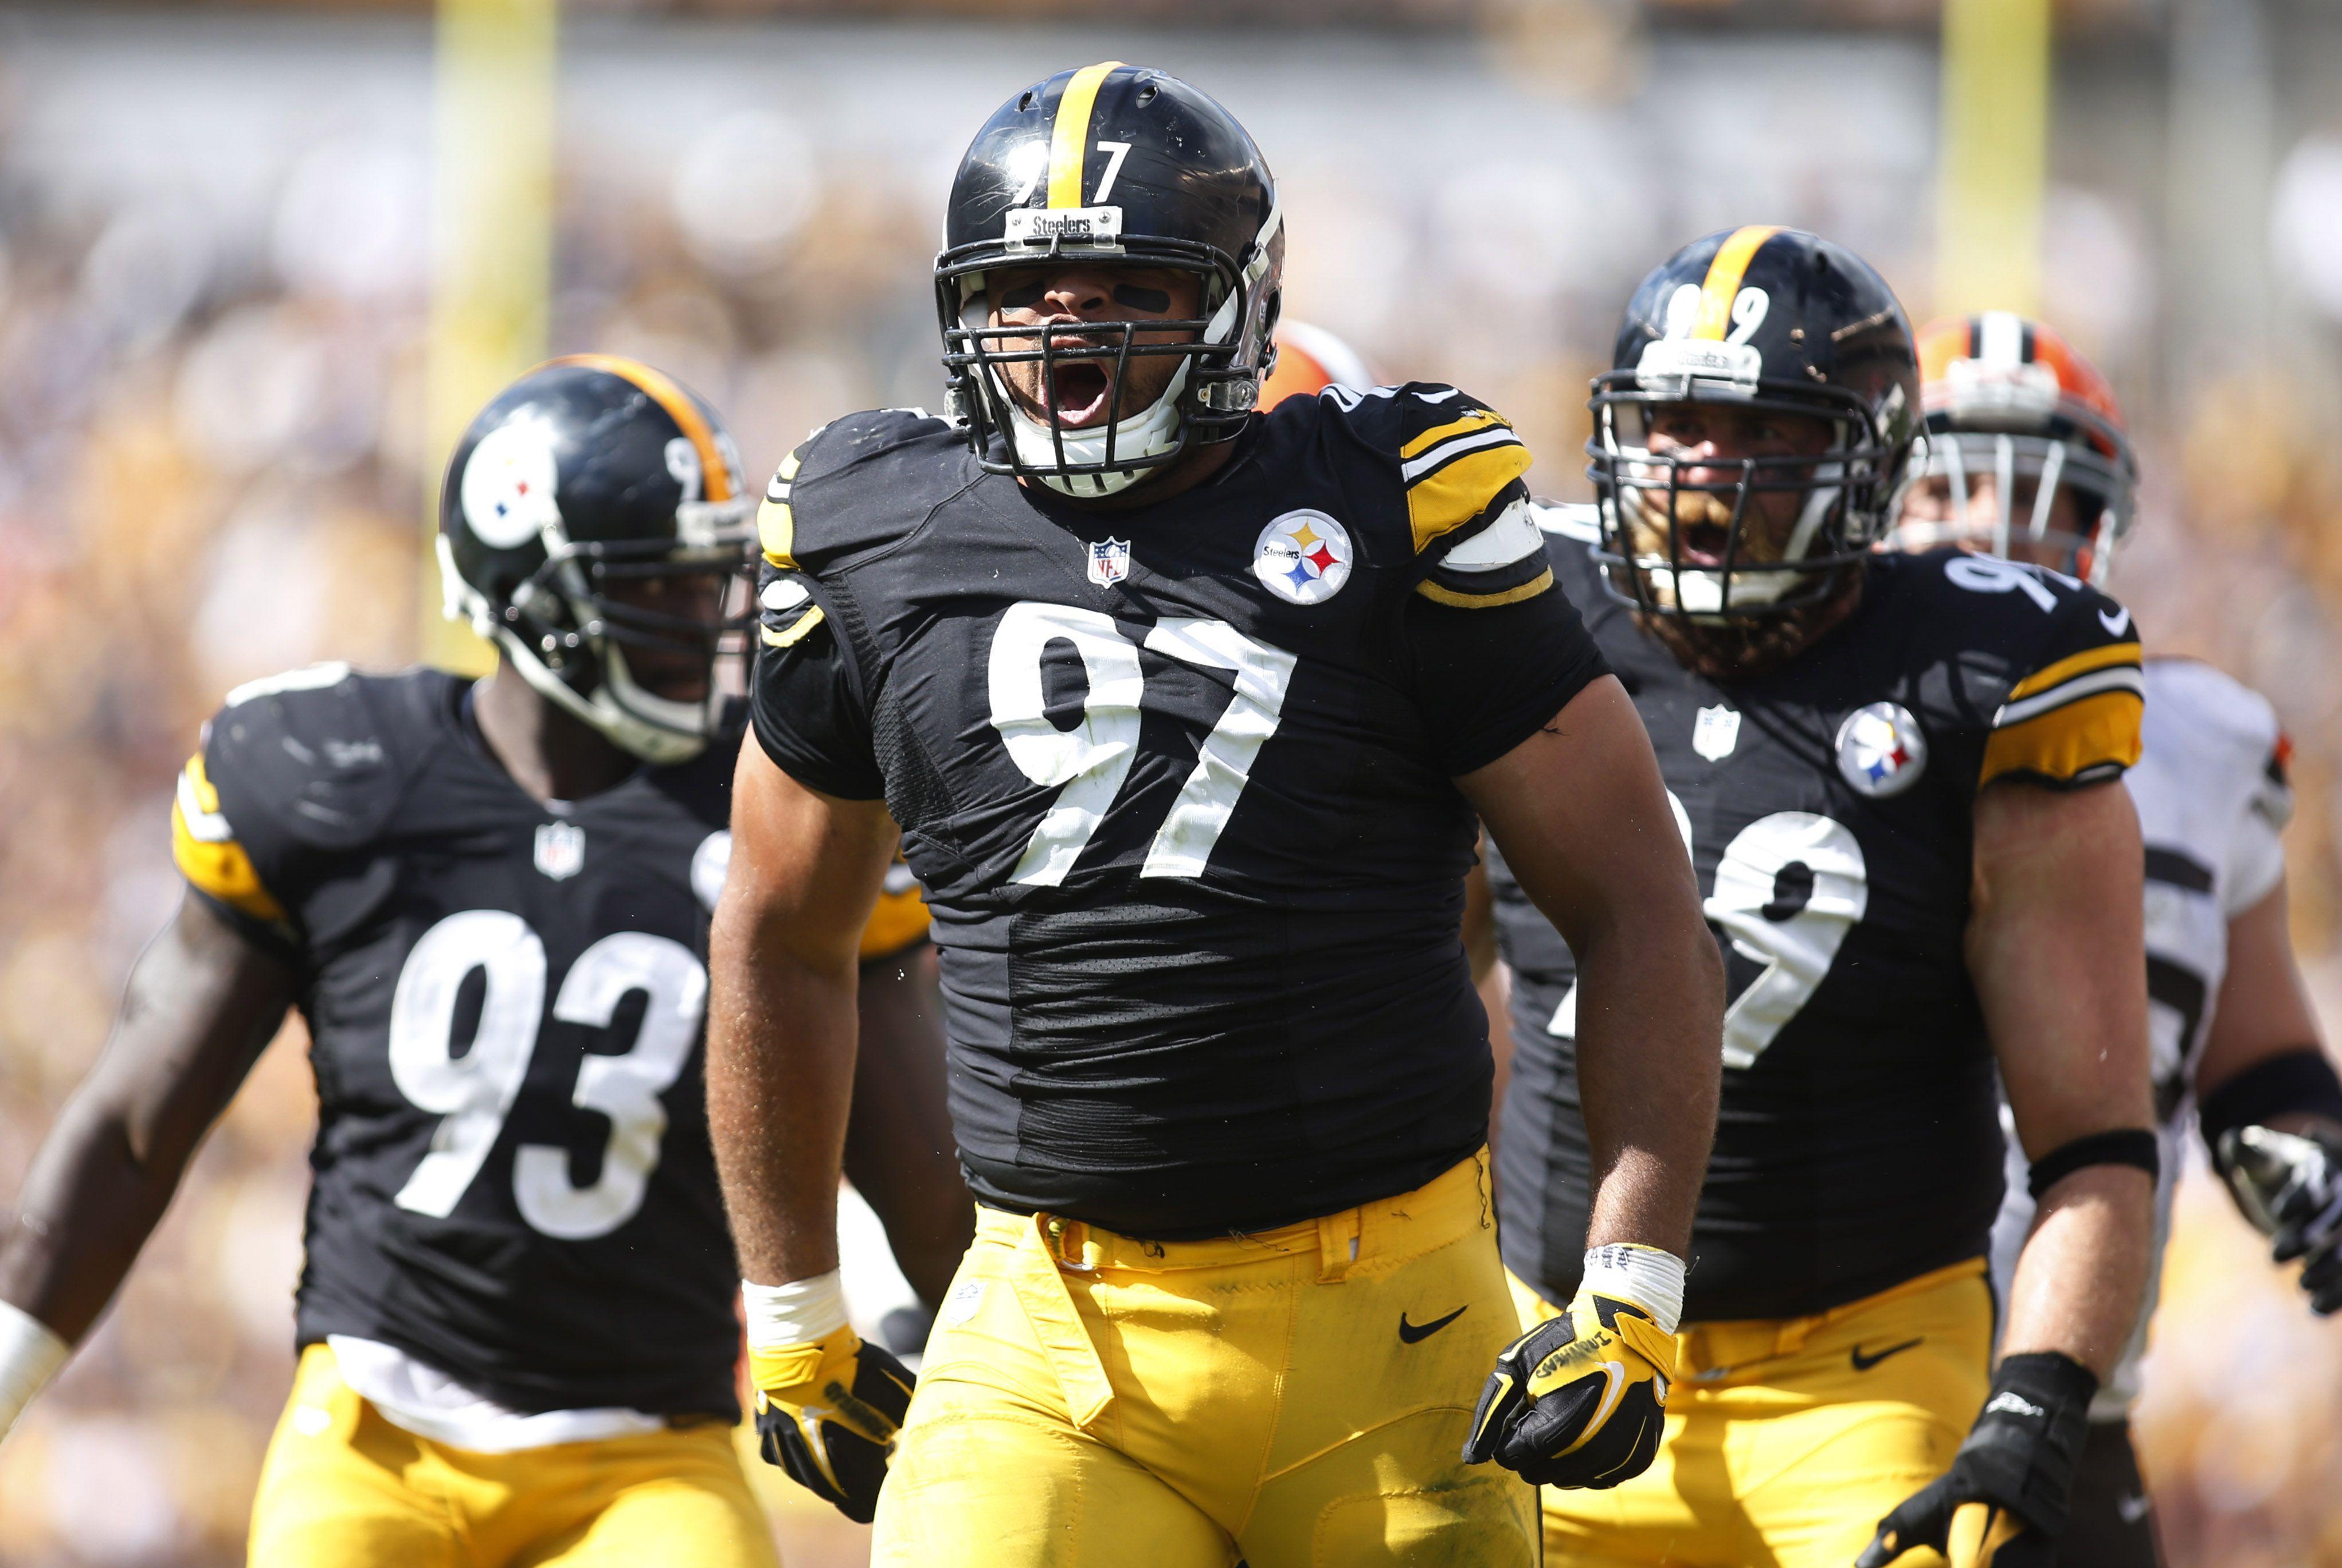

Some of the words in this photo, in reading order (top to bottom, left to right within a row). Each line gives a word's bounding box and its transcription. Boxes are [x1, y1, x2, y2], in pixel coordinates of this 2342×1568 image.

[1006, 140, 1132, 204] 97
[1033, 214, 1090, 236] Steelers
[1096, 559, 1122, 578] NFL
[1263, 546, 1299, 559] Steelers
[1945, 551, 2082, 614] 9
[988, 601, 1298, 887] 97
[389, 910, 708, 1240] 93
